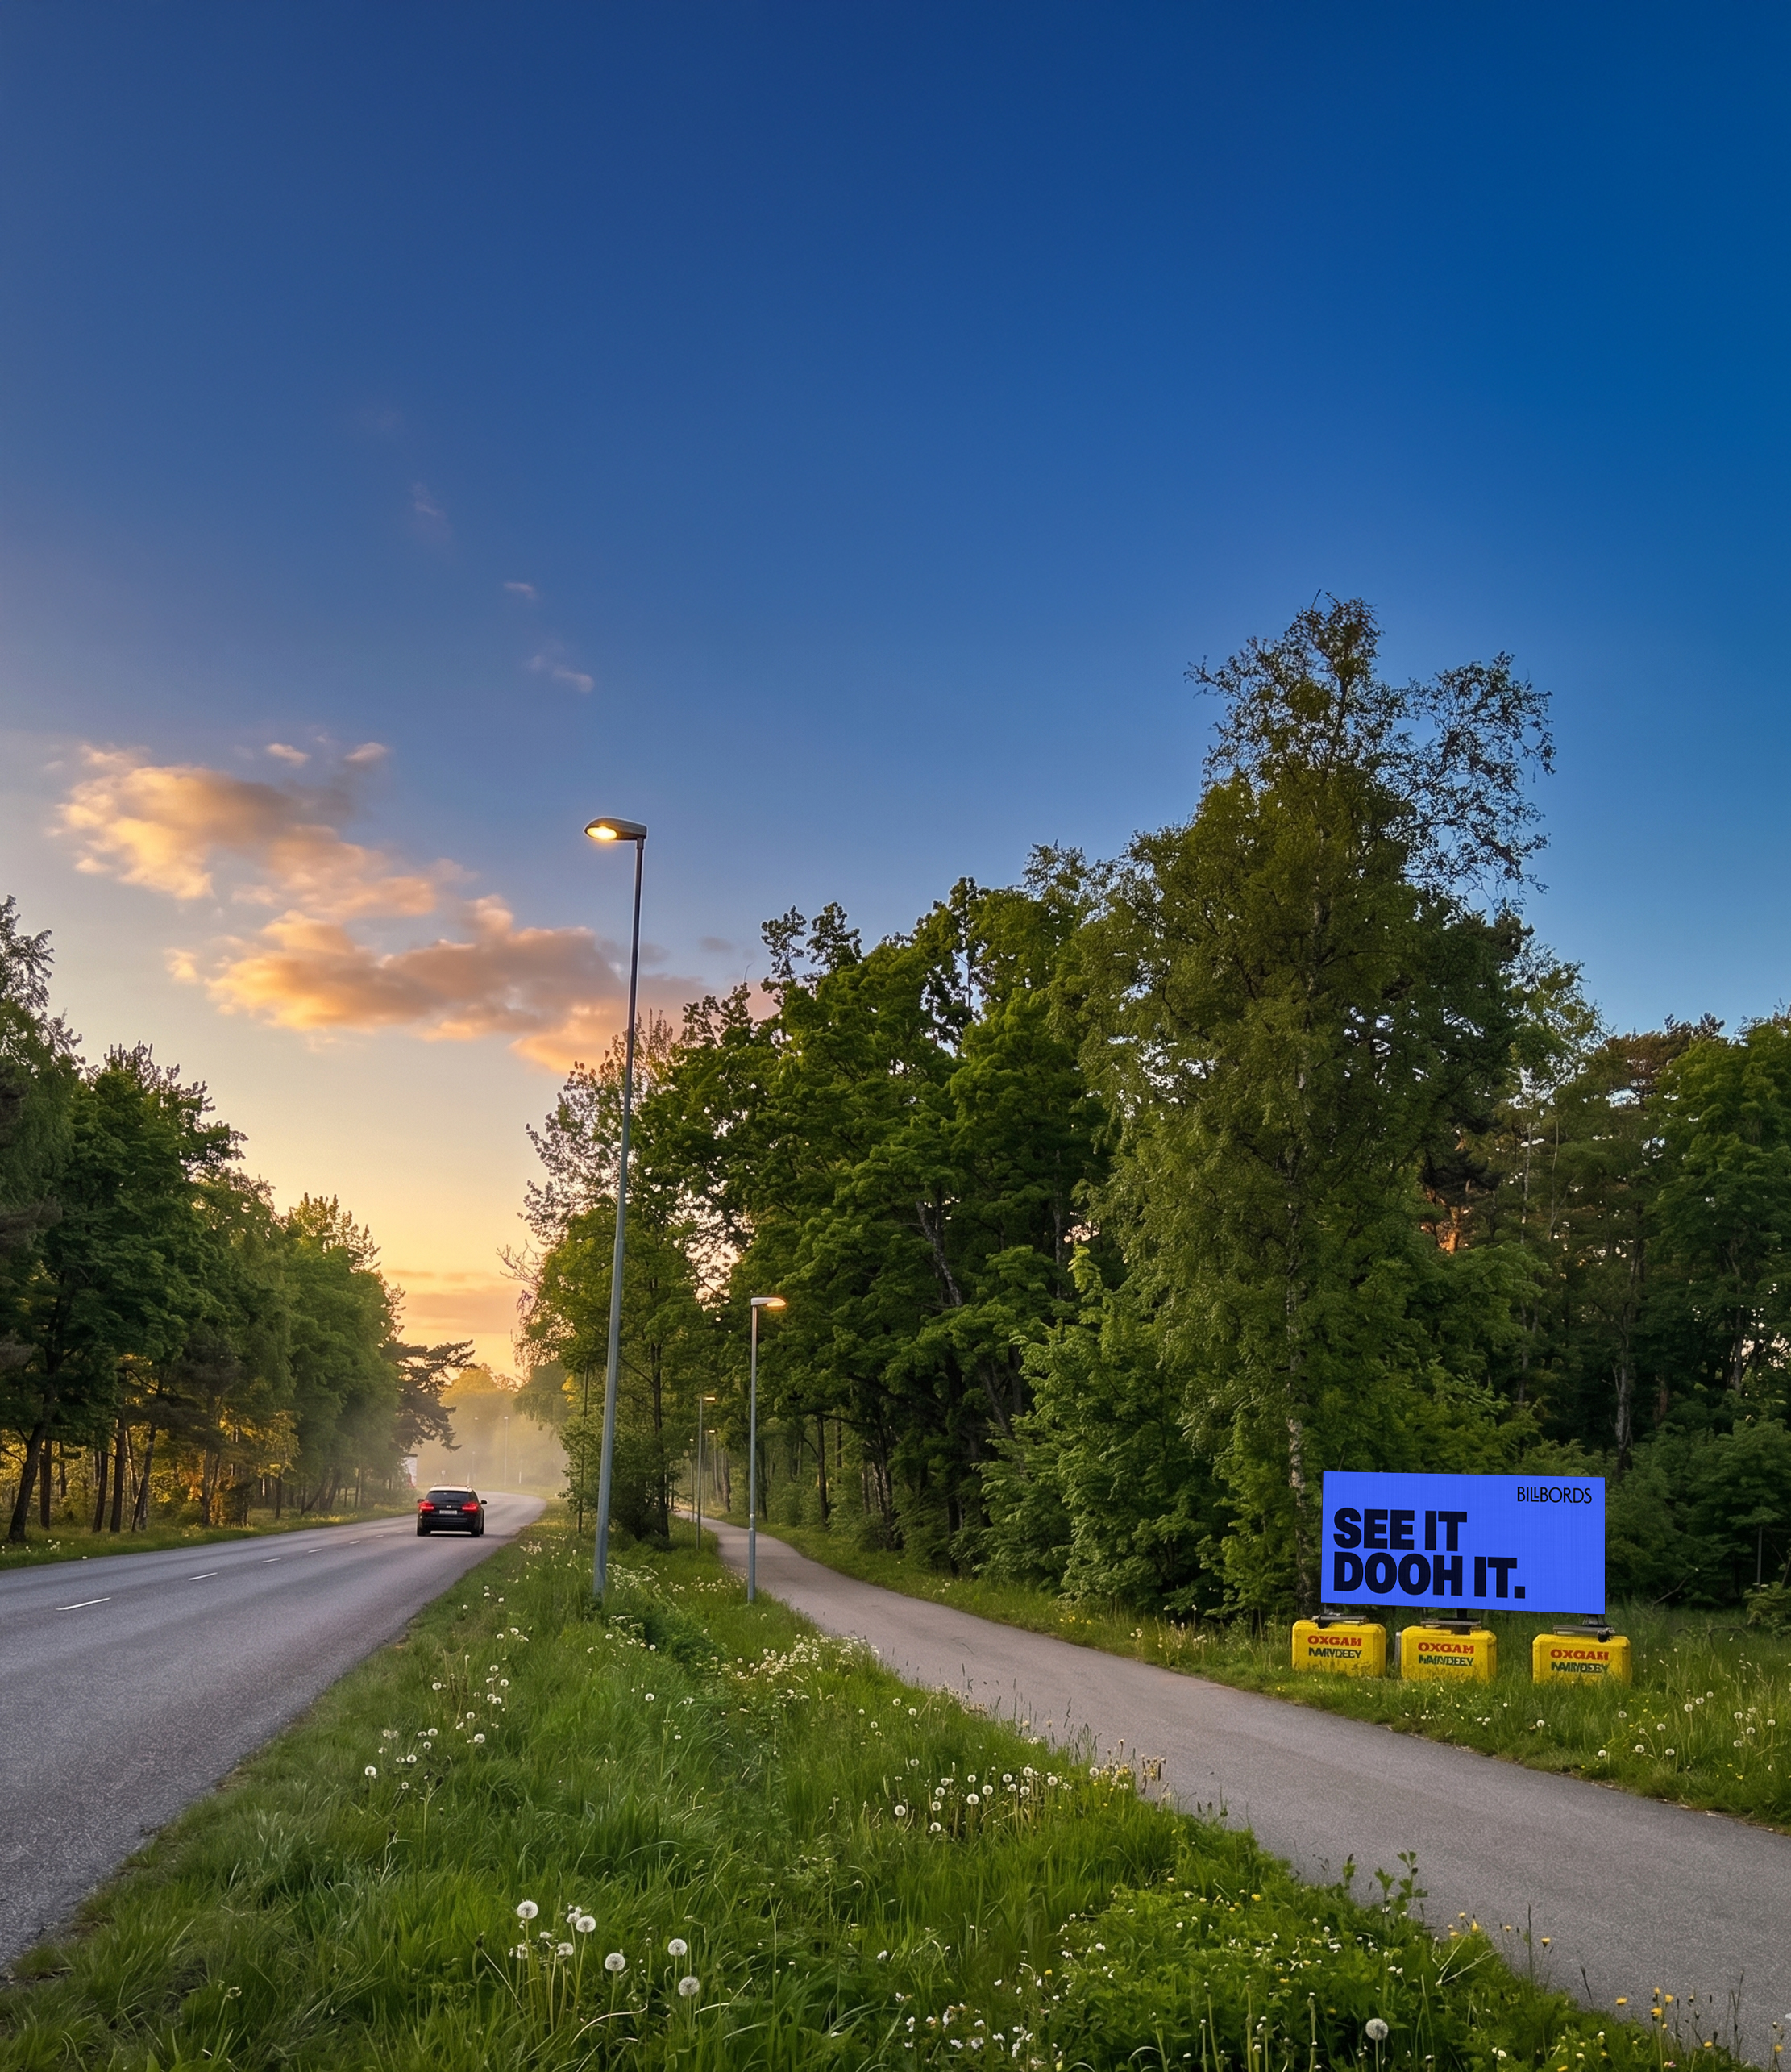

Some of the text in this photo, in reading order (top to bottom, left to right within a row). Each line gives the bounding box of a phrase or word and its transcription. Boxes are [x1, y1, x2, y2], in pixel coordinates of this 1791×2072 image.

[1332, 1507, 1468, 1551] SEE IT
[1333, 1551, 1526, 1599] DOOH IT.
